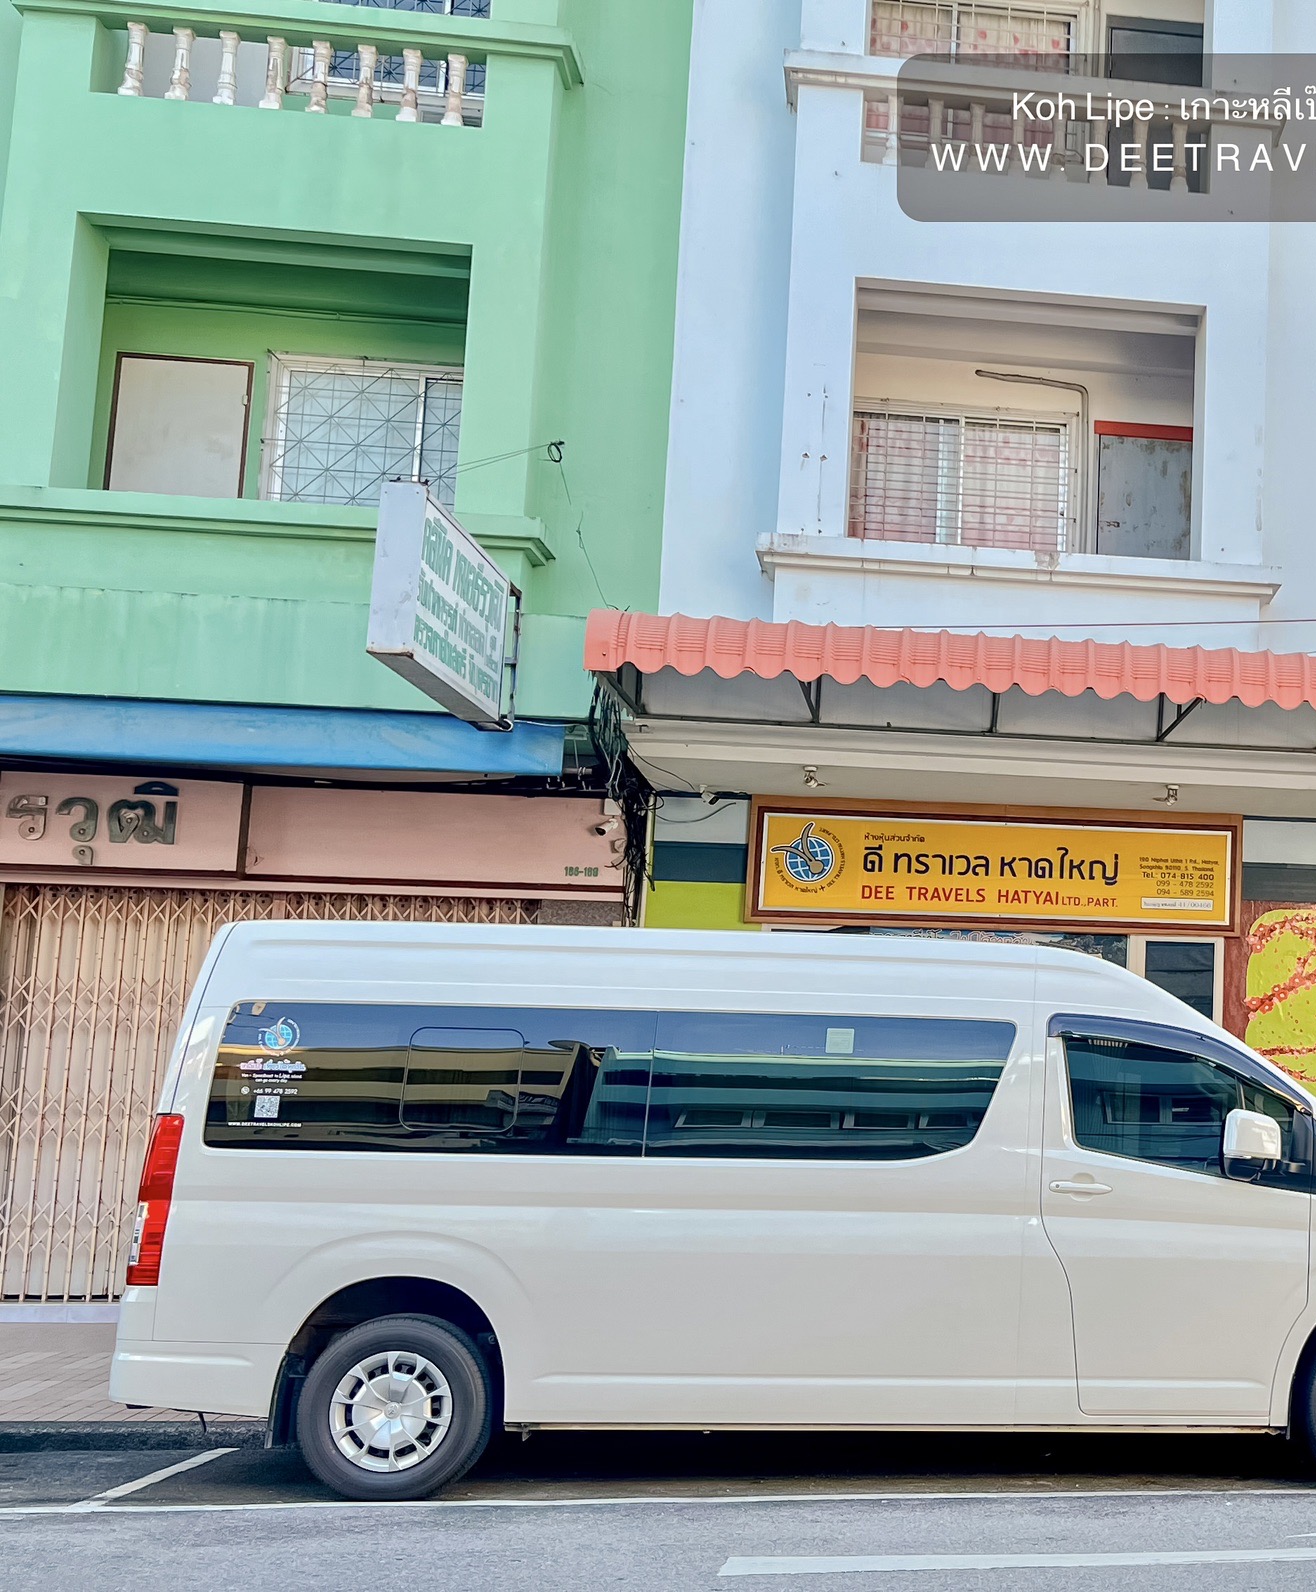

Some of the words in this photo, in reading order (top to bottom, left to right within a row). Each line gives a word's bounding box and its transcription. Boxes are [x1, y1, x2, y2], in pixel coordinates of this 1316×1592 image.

[862, 844, 884, 873] ดี
[893, 852, 990, 877] ทราเวล
[999, 846, 1119, 886] หาดใหญ่
[861, 885, 895, 900] DEE
[905, 886, 986, 903] TRAVELS
[997, 889, 1059, 905] HATYAI
